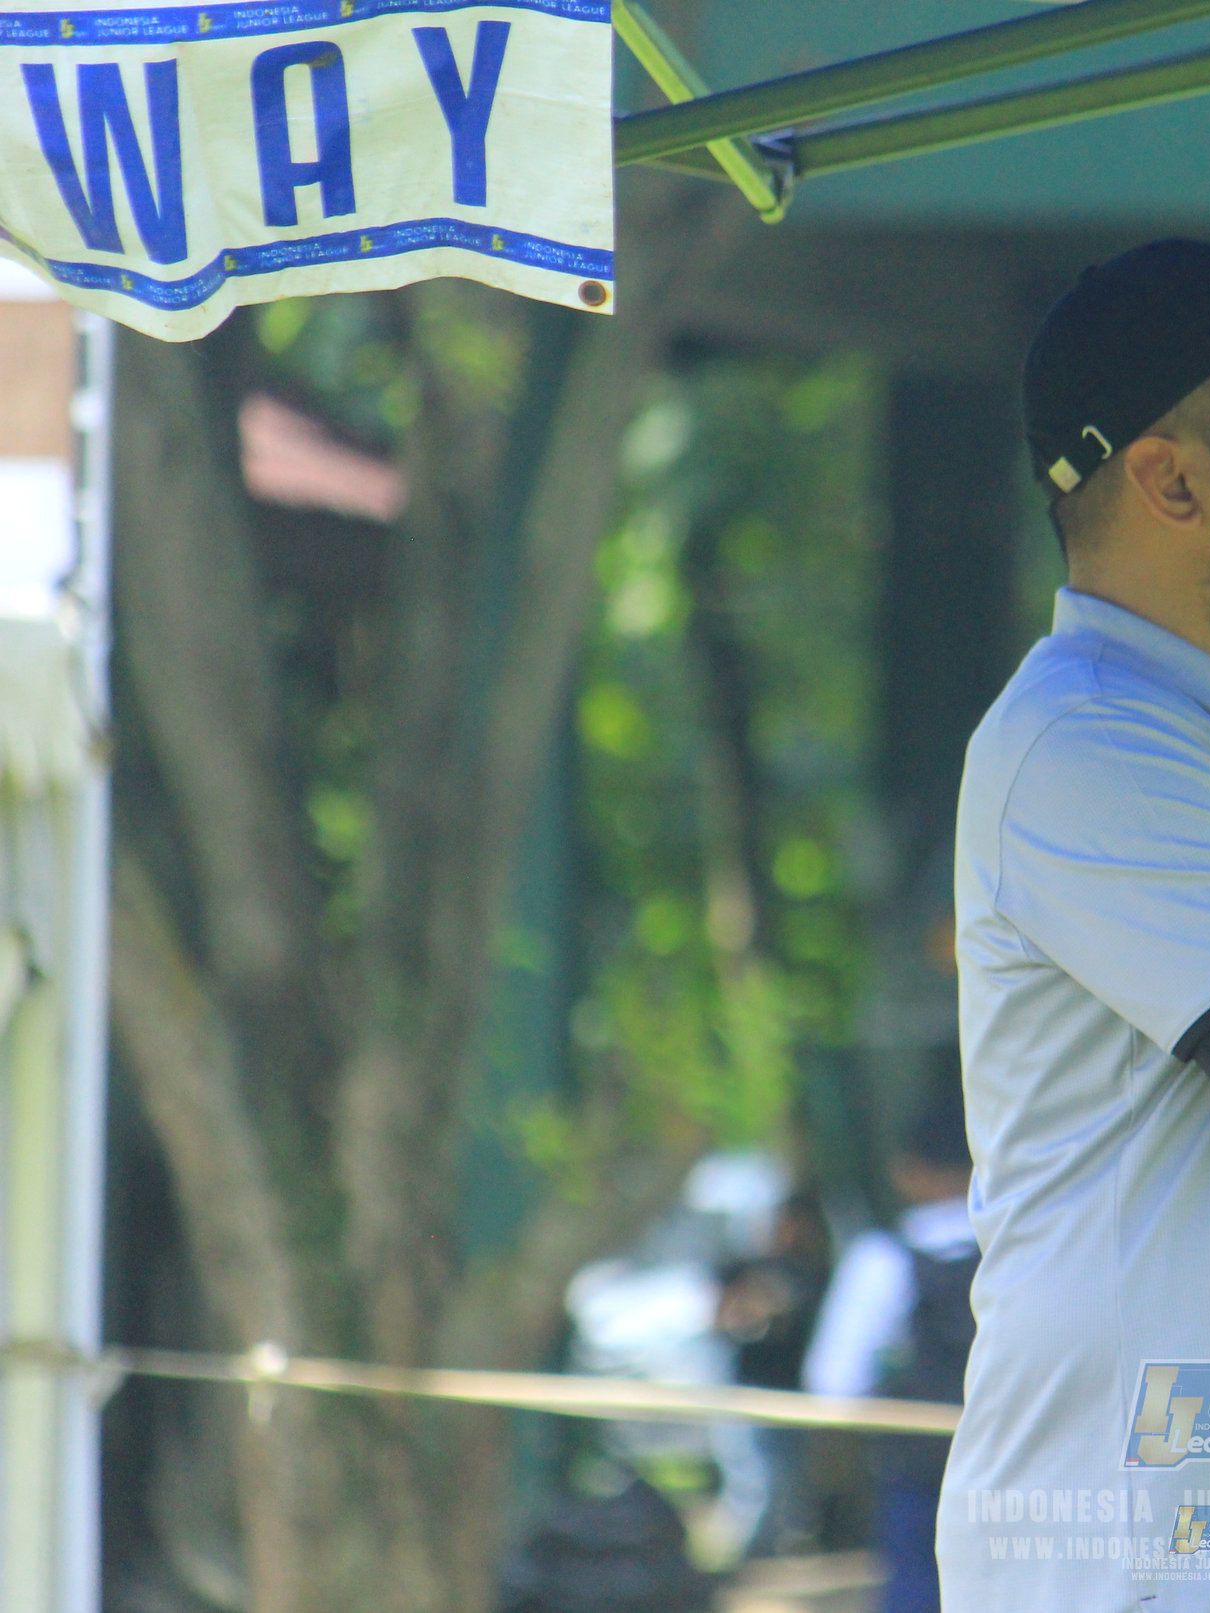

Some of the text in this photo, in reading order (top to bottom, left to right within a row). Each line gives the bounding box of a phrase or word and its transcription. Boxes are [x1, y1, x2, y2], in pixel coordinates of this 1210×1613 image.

[234, 6, 299, 19] INDONESIA
[562, 3, 605, 16] LEAGUE
[95, 17, 160, 27] INDONESIA
[237, 18, 278, 29] JUNIOR
[284, 12, 328, 25] LEAGUE
[144, 25, 188, 36] LEAGUE
[19, 20, 511, 265] WAY
[524, 241, 583, 261] INDONESIA
[567, 258, 609, 274] LEAGUE
